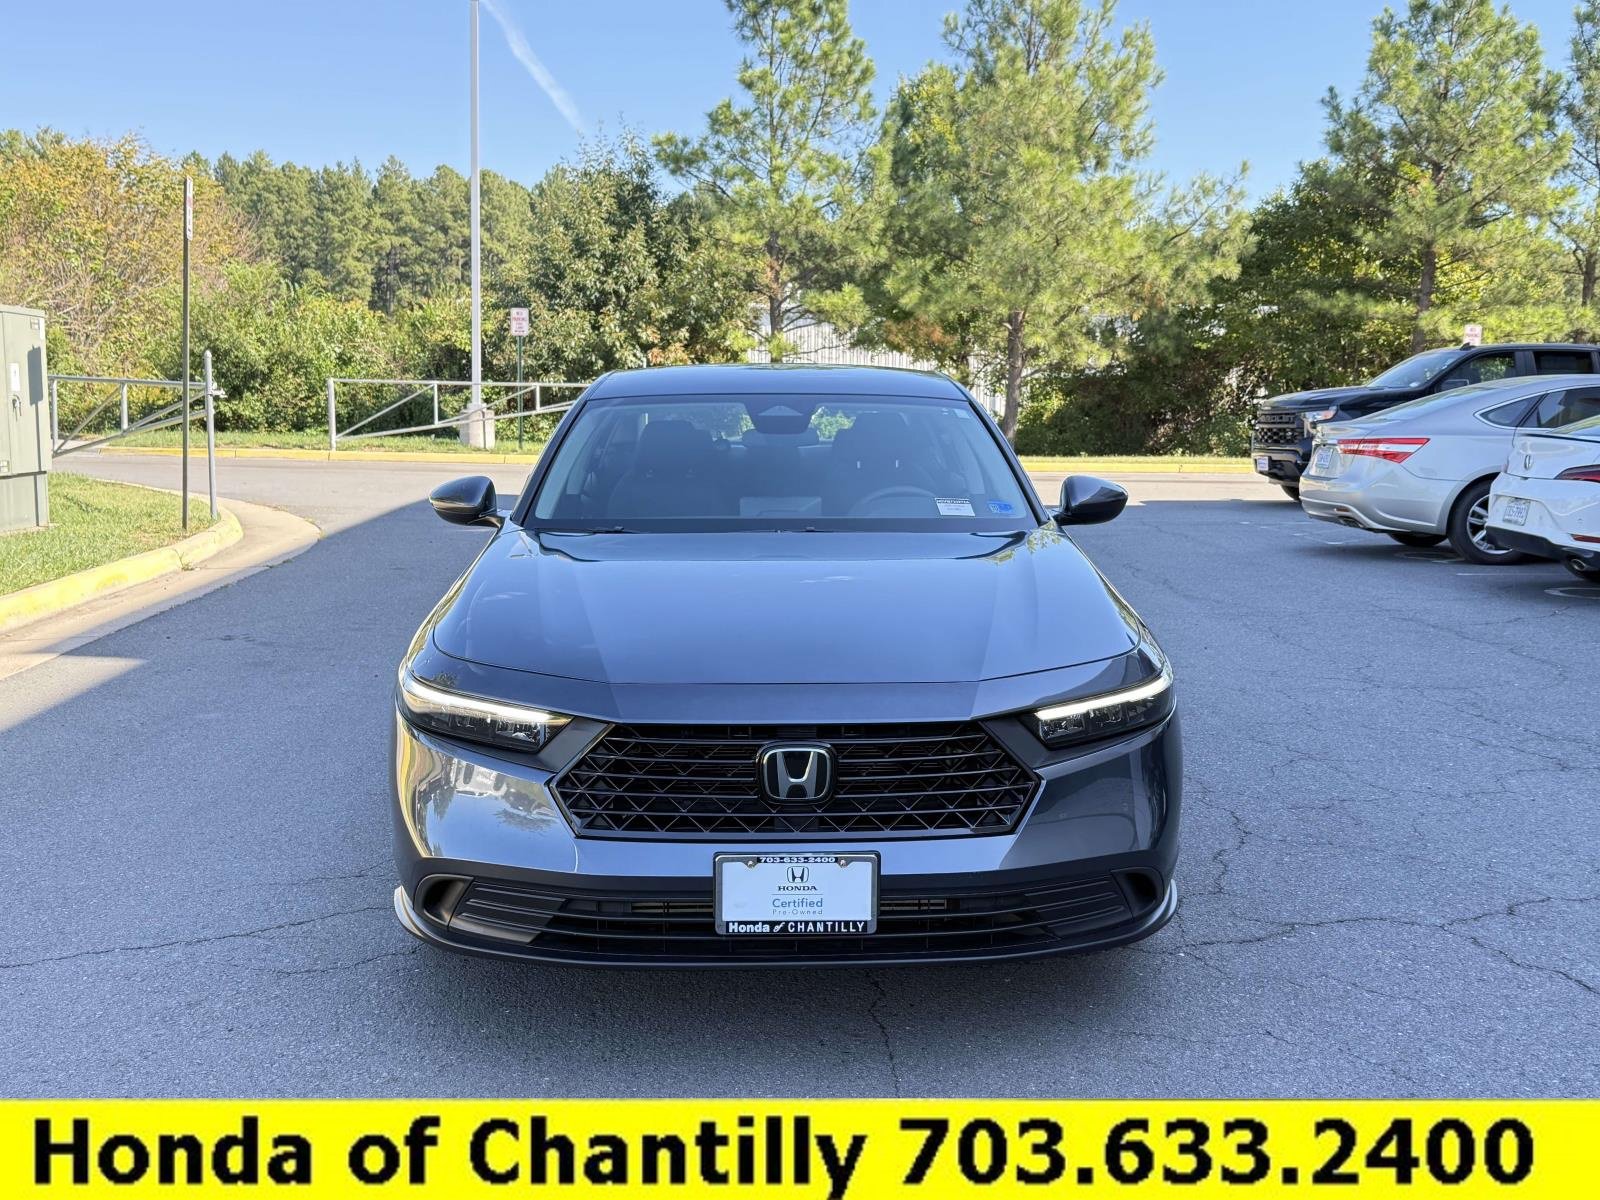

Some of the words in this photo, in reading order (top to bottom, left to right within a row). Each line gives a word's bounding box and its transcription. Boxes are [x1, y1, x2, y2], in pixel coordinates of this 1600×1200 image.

[759, 856, 836, 864] 703-633-2400
[772, 897, 823, 908] Certified
[772, 908, 823, 916] Pre-Owned
[728, 922, 770, 933] Honda
[773, 922, 785, 933] of
[788, 921, 865, 933] CHANTILLY
